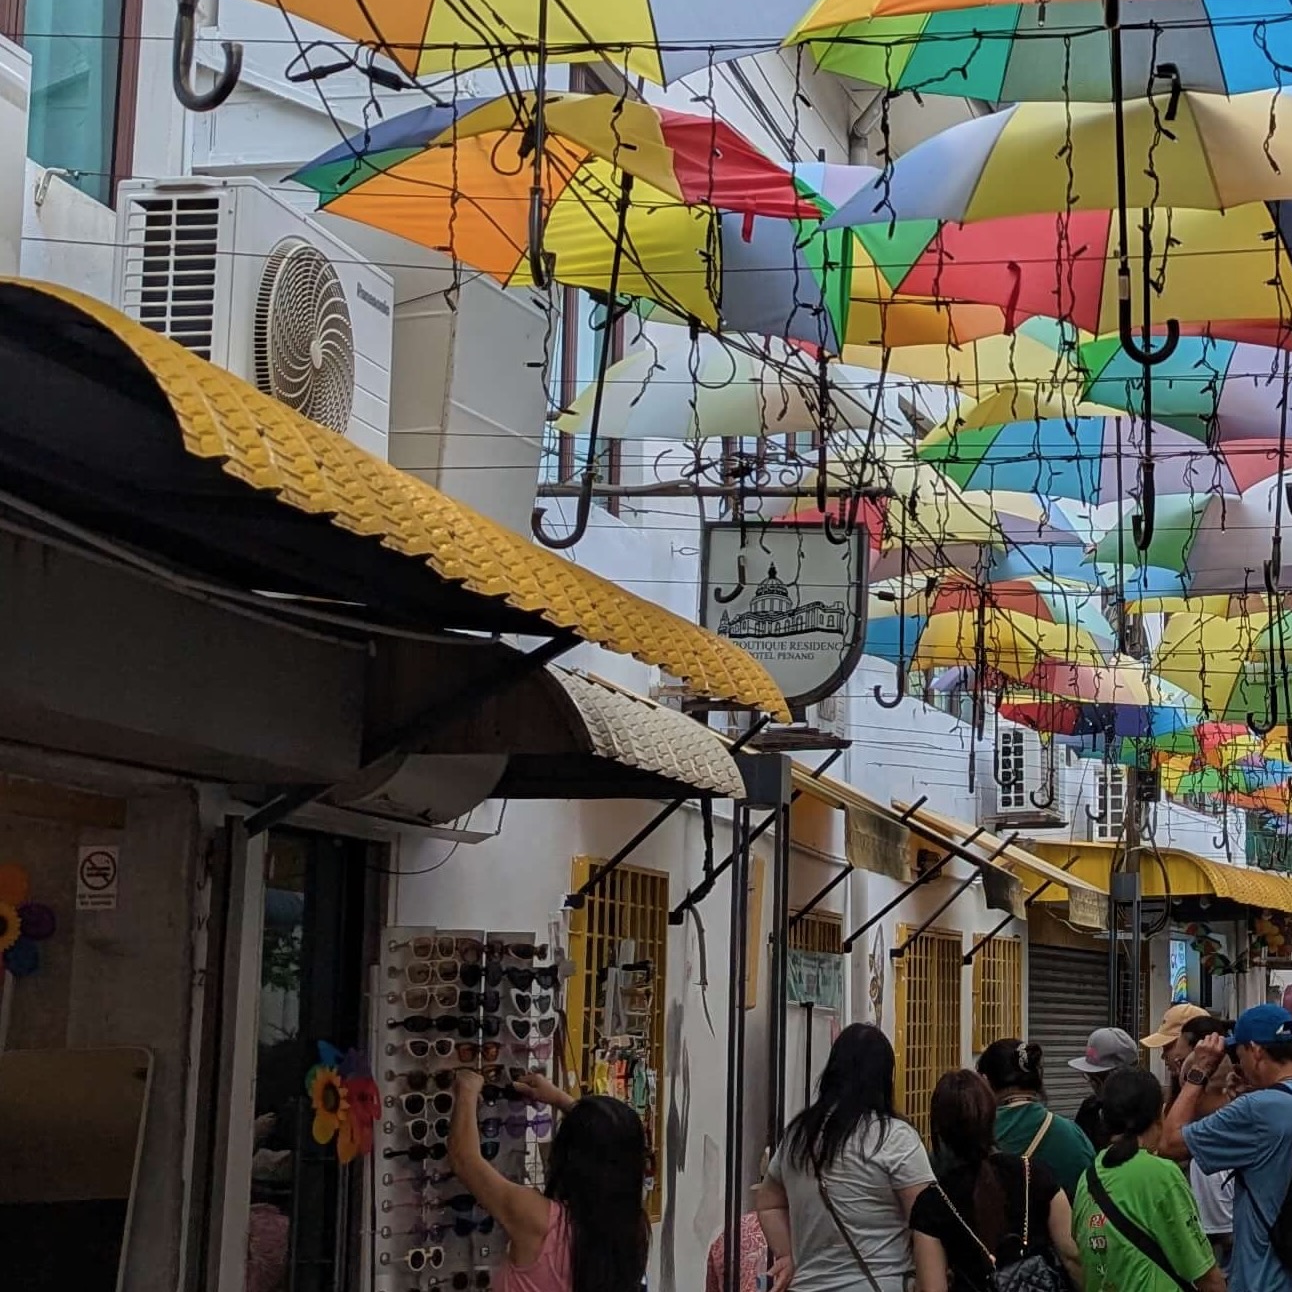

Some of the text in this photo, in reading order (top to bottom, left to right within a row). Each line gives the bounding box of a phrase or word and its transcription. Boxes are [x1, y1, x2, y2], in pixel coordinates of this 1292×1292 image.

[789, 641, 848, 651] RESIDENC
[750, 651, 815, 661] OTEL PENANG
